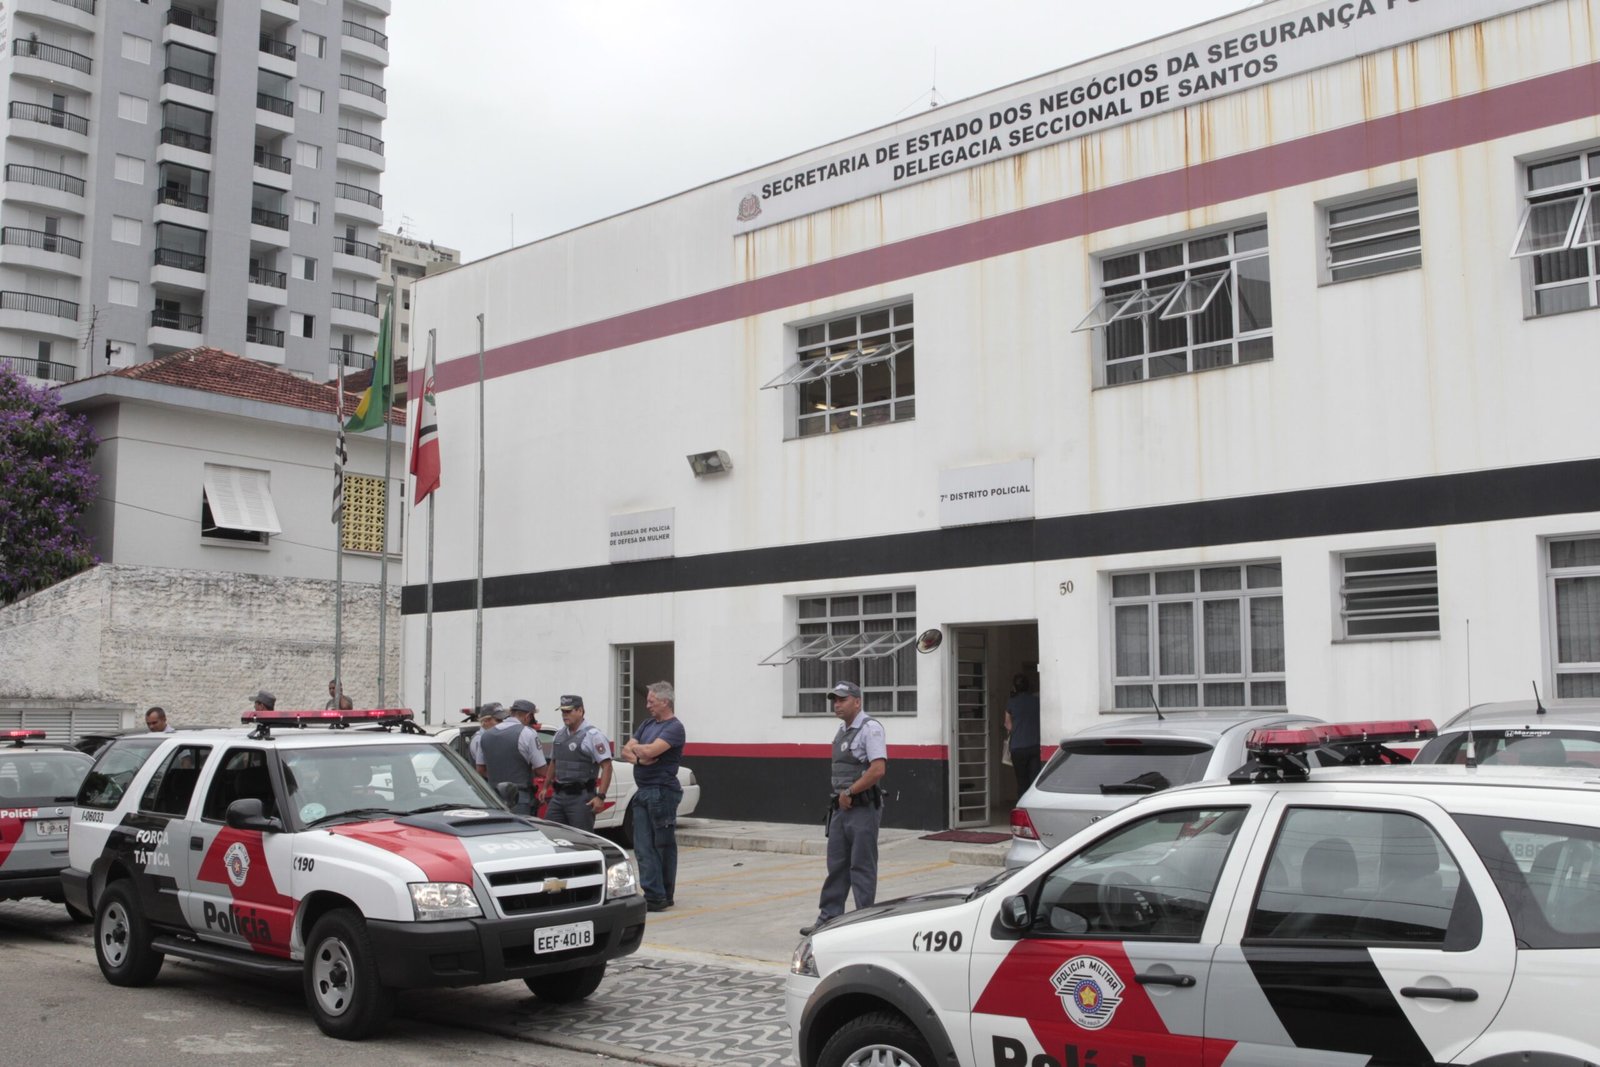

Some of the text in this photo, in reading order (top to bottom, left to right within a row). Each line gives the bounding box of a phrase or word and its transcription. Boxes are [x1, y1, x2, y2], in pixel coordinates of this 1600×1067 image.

[762, 0, 1376, 200] SECRETARIA DE ESTADO DOS NEGÓCIOS DA SEGURANÇA
[893, 54, 1278, 181] DELEGACIA SECCIONAL DE SANTOS
[950, 489, 988, 501] DISTRITO
[991, 485, 1031, 496] POLICIAL
[610, 528, 639, 538] DELEGACIA
[618, 536, 638, 545] DEFESA
[647, 533, 670, 542] MULHER
[1059, 580, 1074, 596] 50
[136, 830, 169, 847] FORÇA
[134, 848, 171, 867] TÁTICA
[297, 857, 315, 872] 190
[203, 900, 272, 943] Polícia
[922, 930, 963, 952] 190
[1088, 961, 1119, 990] MILITAR
